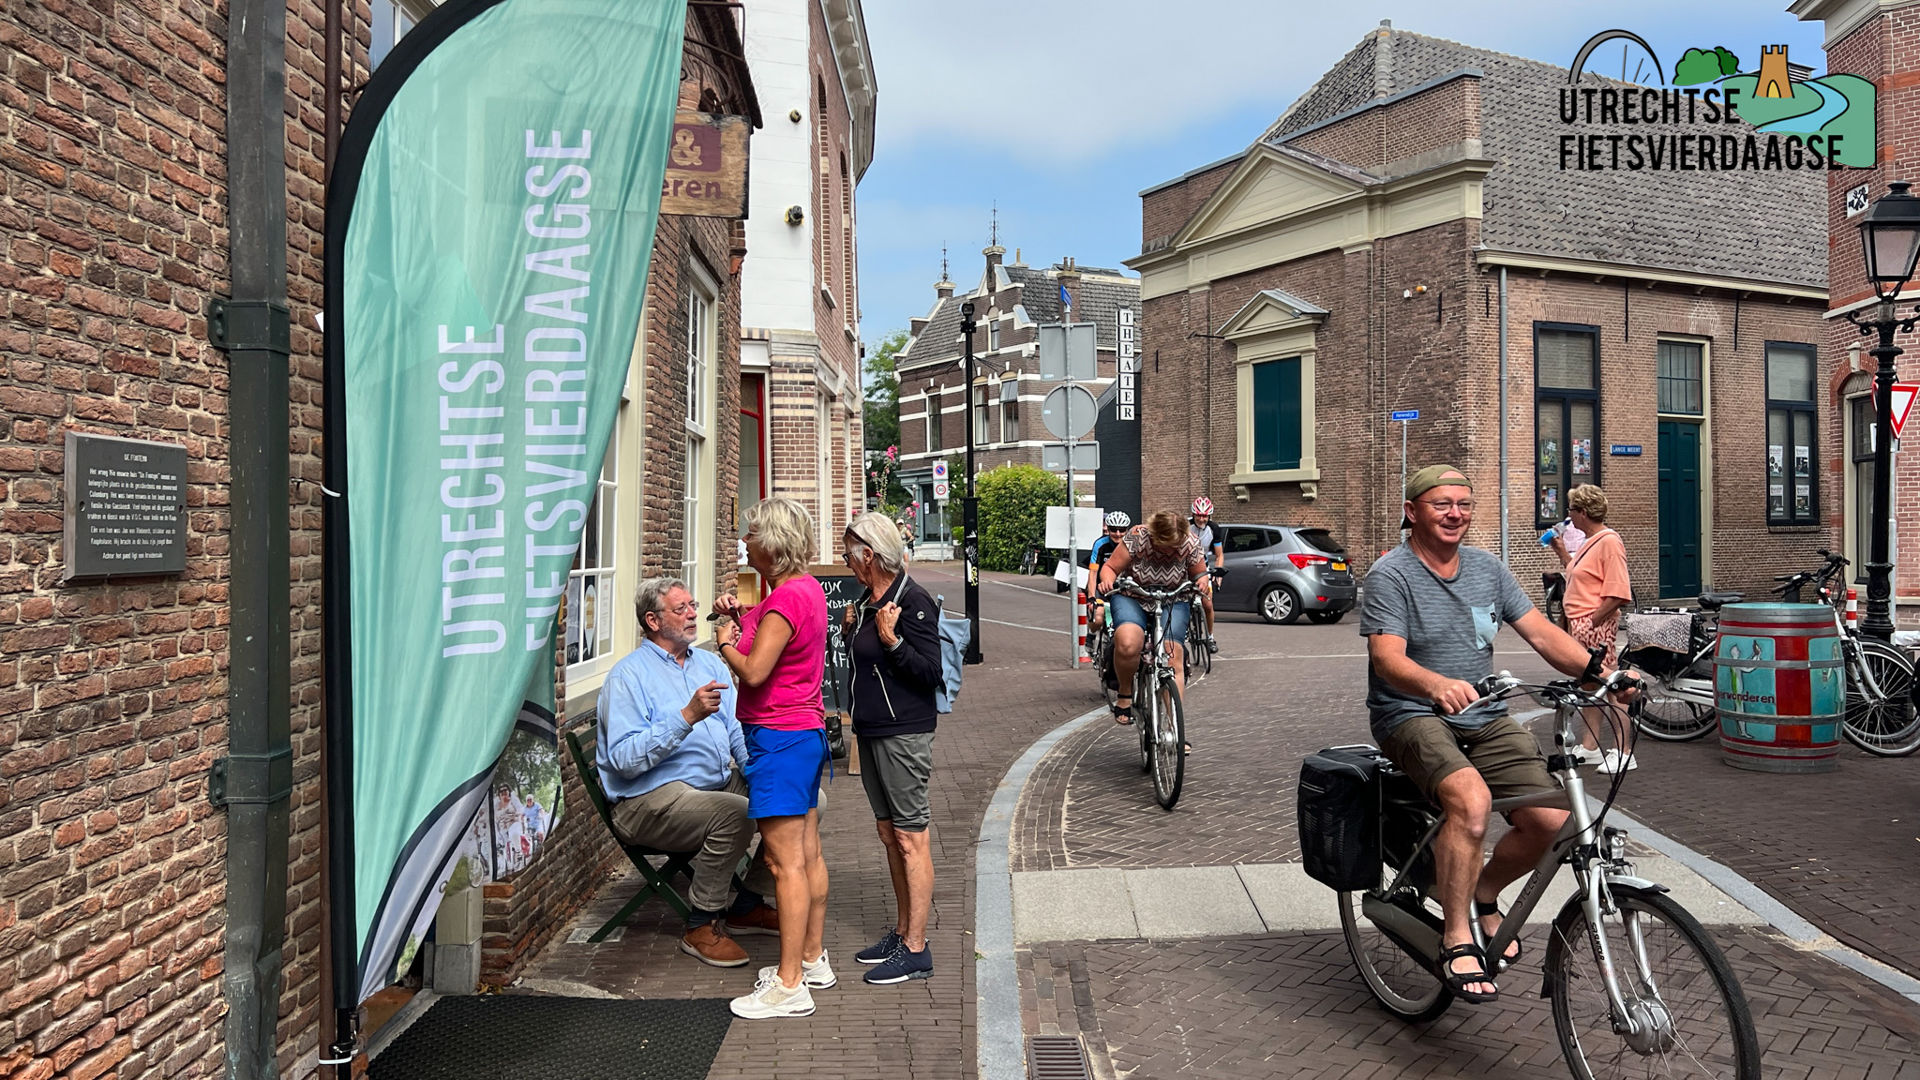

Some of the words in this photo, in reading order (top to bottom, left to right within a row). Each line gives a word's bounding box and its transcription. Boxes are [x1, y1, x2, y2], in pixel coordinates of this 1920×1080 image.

[671, 128, 703, 166] &
[524, 128, 591, 651] FIETSVIERDAAGSE
[1122, 312, 1132, 418] THEATER
[438, 323, 506, 658] UTRECHTSE
